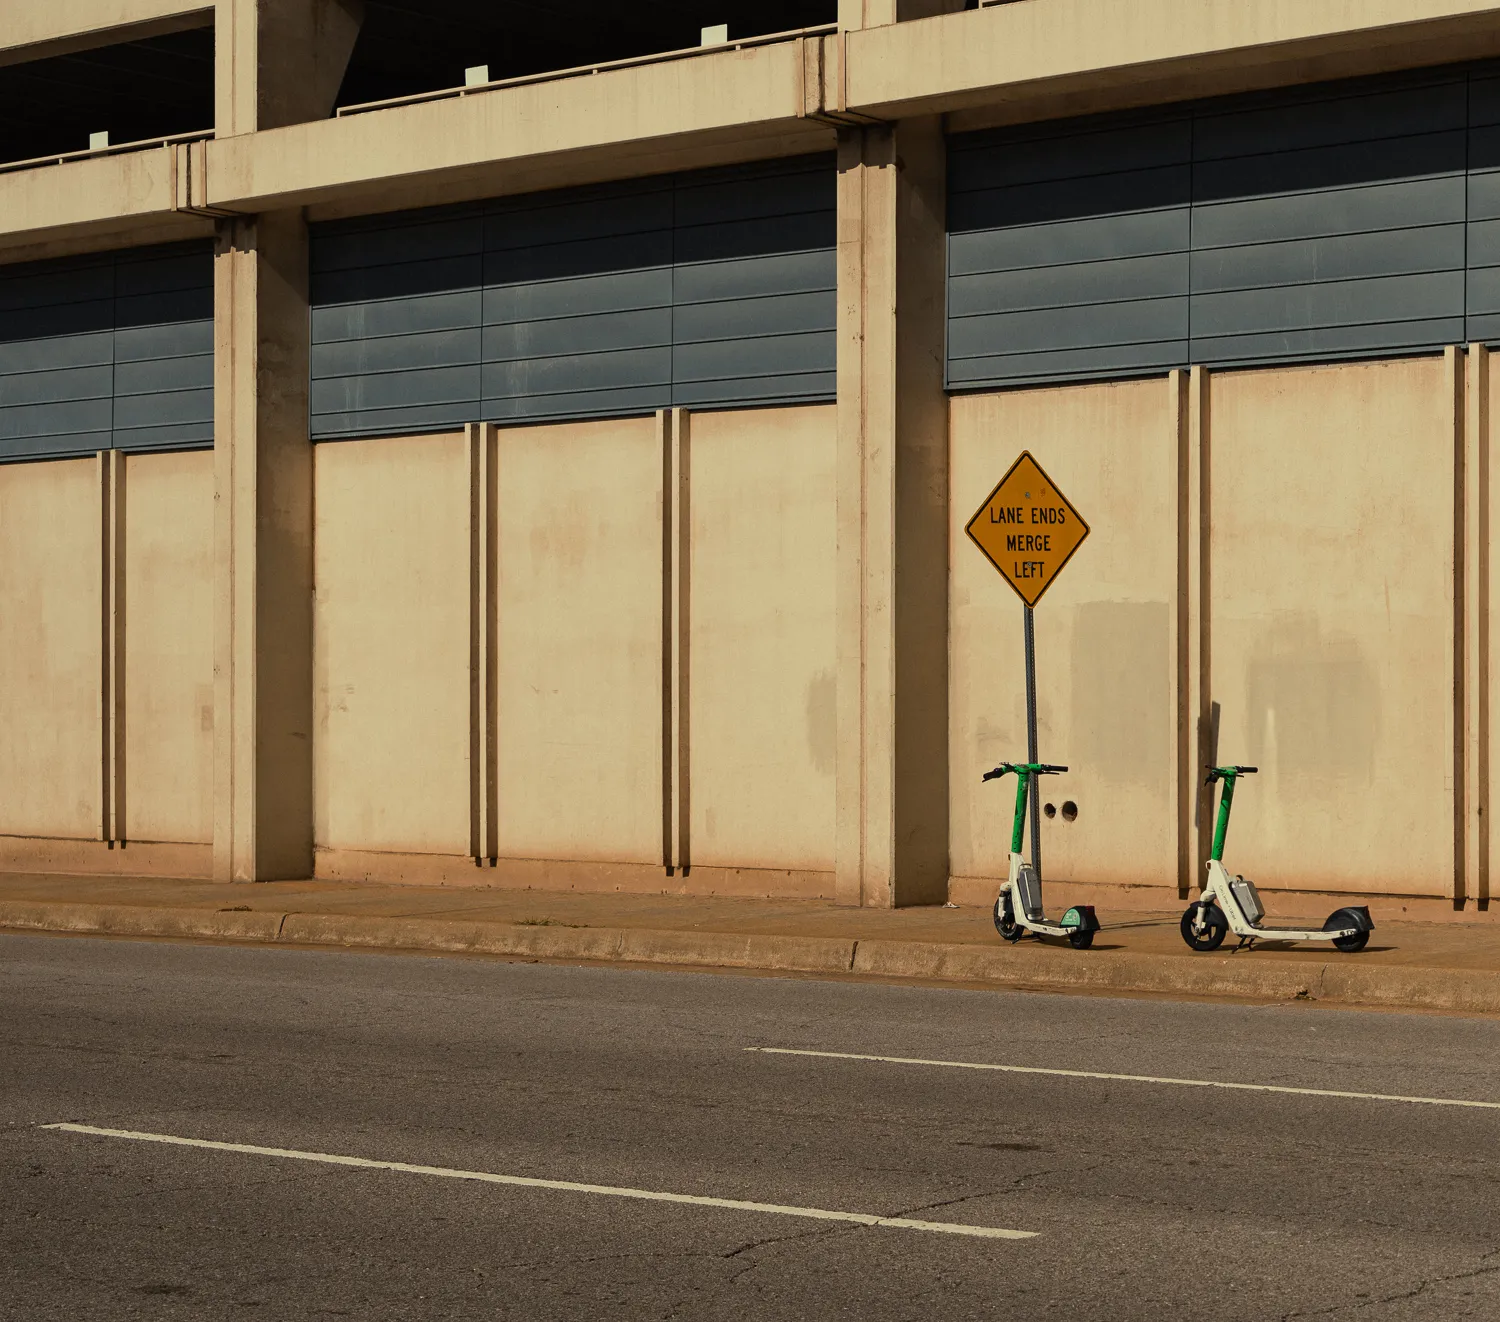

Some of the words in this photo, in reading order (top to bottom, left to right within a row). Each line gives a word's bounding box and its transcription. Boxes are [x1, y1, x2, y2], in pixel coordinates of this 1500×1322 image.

[990, 507, 1024, 524] LANE
[1031, 507, 1066, 525] ENDS
[1006, 534, 1052, 552] MERGE
[1014, 561, 1045, 578] LEFT
